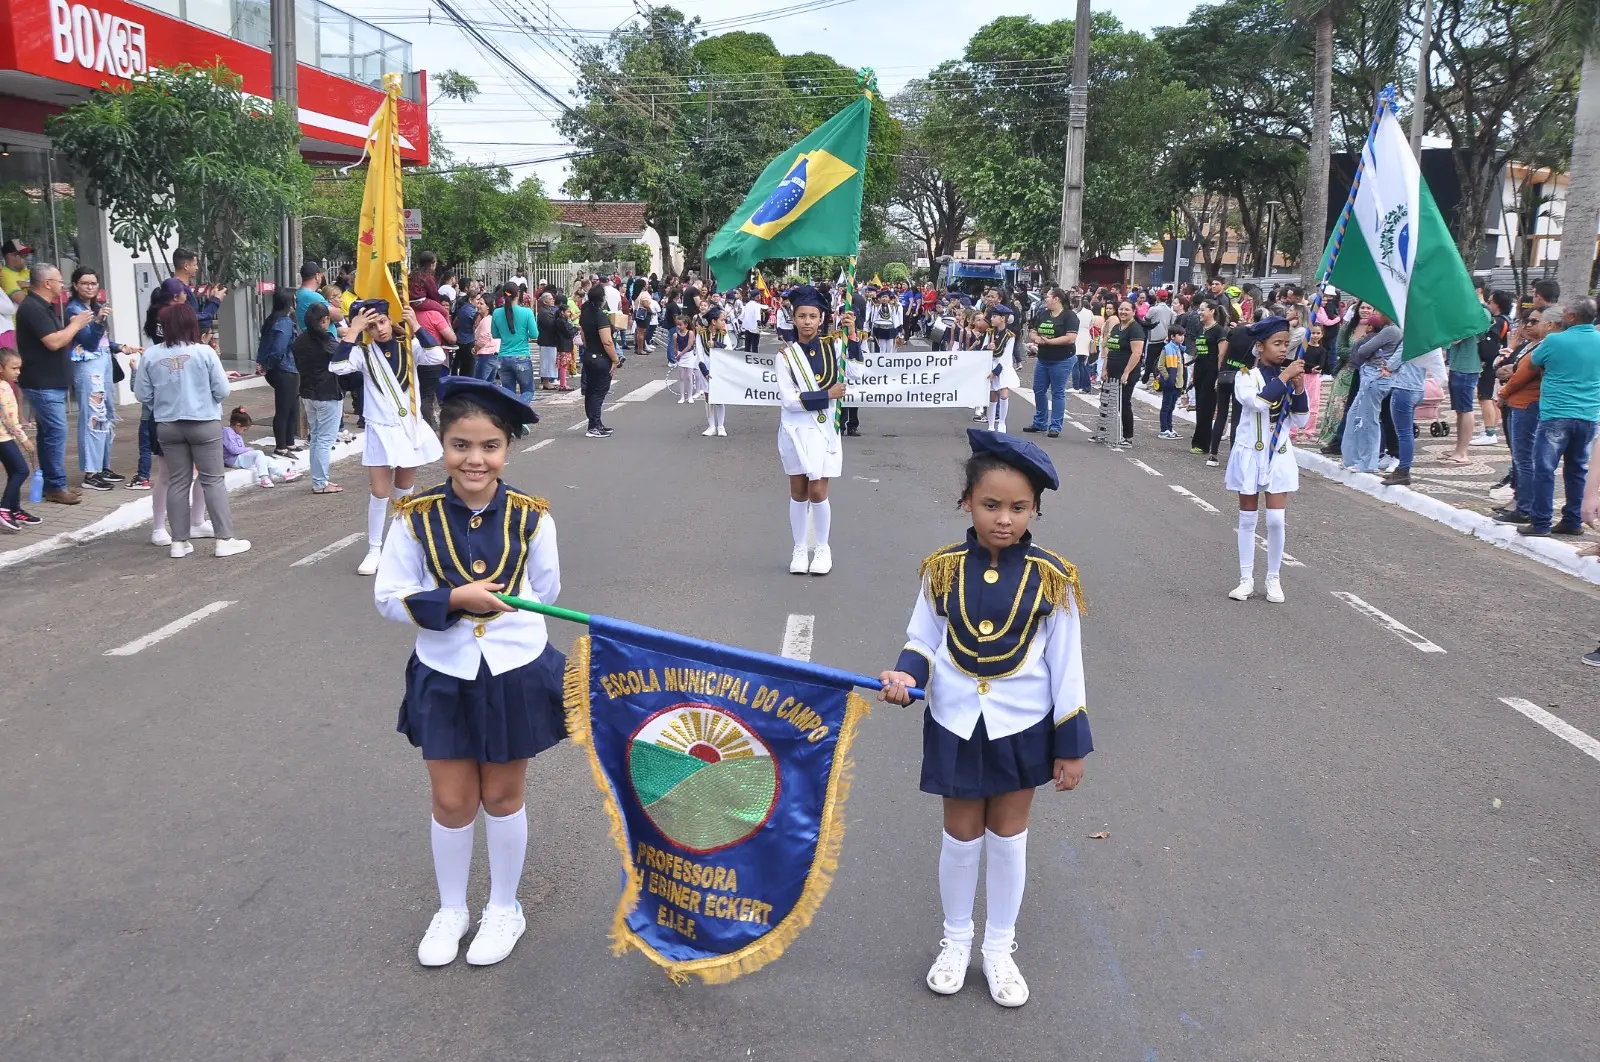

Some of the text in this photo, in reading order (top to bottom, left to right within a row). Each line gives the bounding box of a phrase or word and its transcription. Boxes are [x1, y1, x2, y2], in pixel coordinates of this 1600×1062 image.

[49, 0, 147, 82] BOX35
[745, 354, 774, 366] Esco
[877, 356, 922, 370] Campo
[900, 372, 940, 385] E.I.E.F
[859, 391, 903, 405] Tempo
[907, 389, 958, 405] Integral
[600, 667, 830, 743] ESCOLA MUNICIPAL DO CAMPO
[637, 842, 737, 893] PROFESSORA
[648, 871, 702, 914] EBINER
[704, 894, 773, 925] ECKERT
[656, 904, 697, 940] E.I.E.F.
